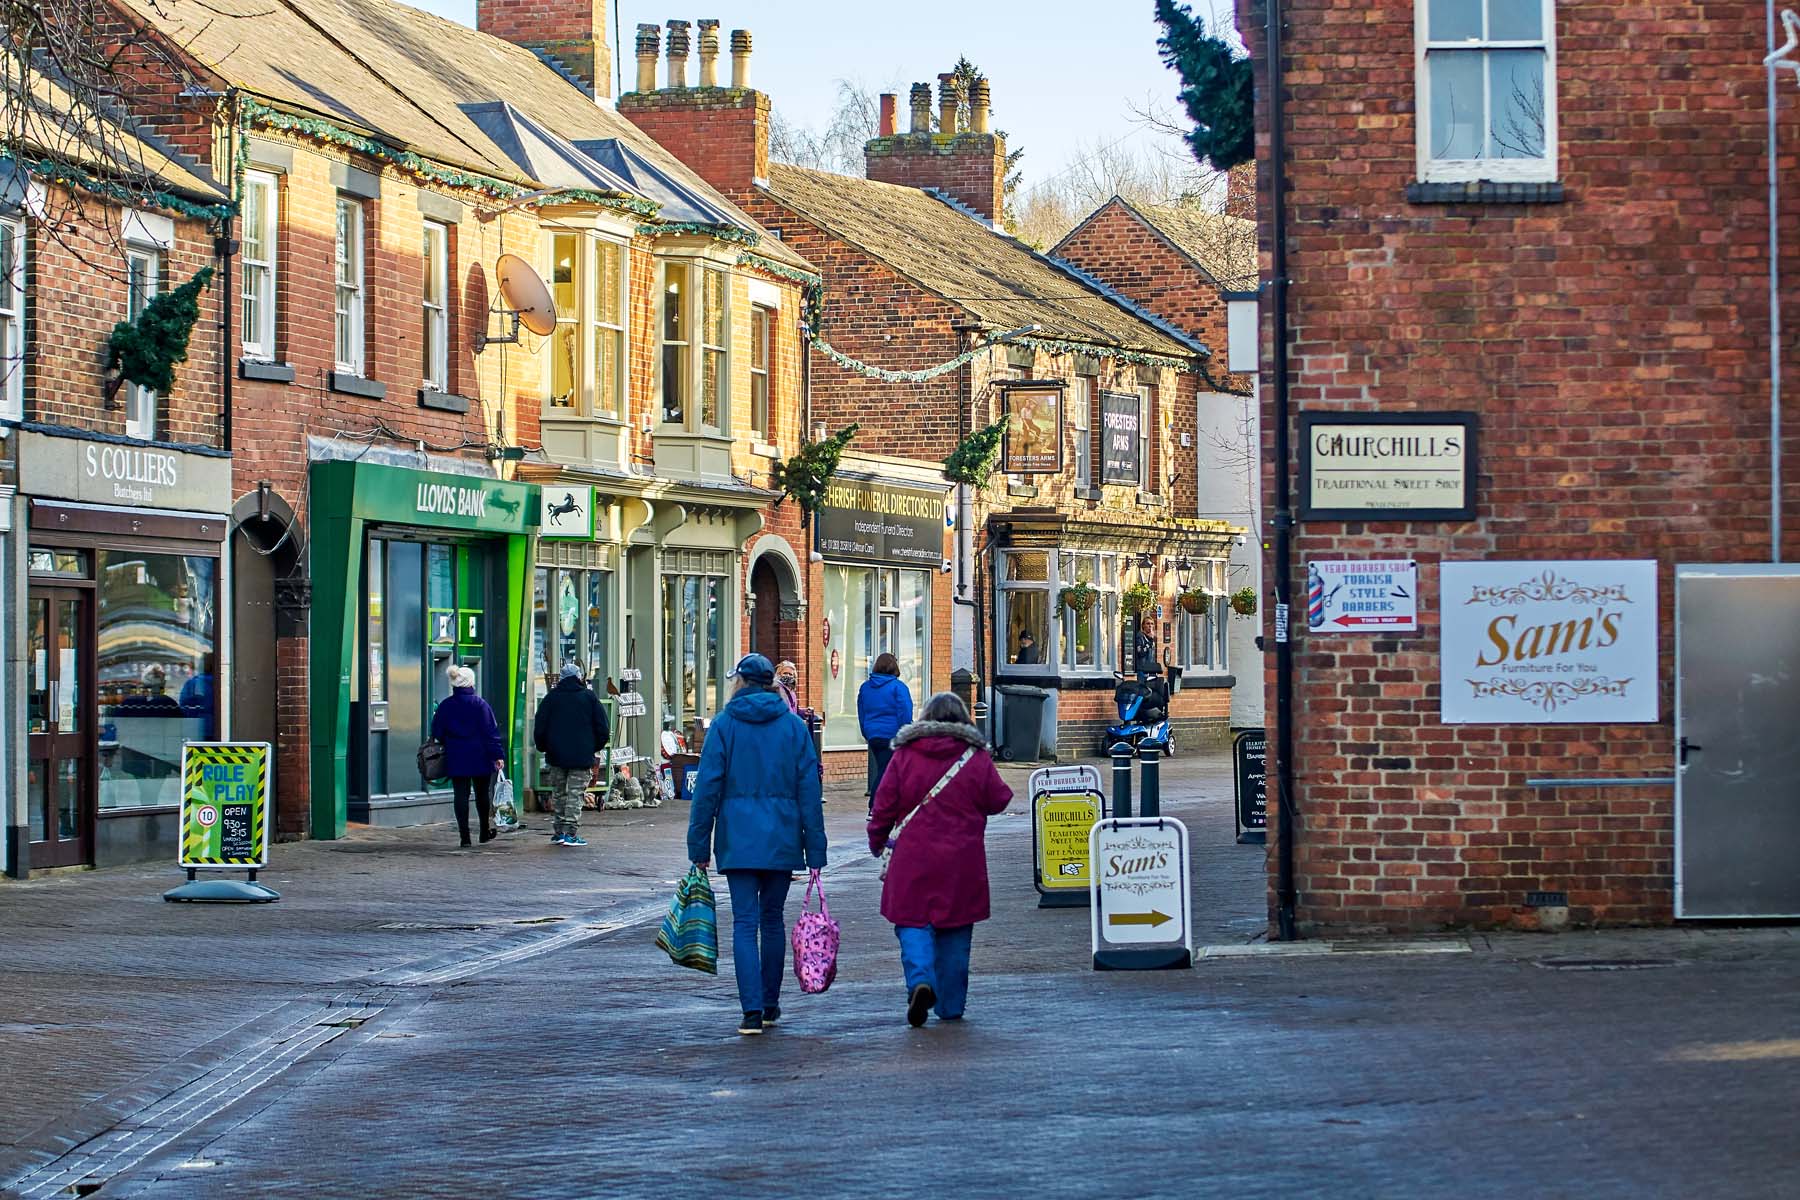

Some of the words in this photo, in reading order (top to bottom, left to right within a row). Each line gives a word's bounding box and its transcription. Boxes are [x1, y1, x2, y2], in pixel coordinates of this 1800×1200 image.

[1104, 412, 1137, 431] FORESTERS
[1112, 434, 1129, 451] ARMS
[1316, 433, 1461, 458] CHURCHILLS
[86, 444, 97, 477] S
[101, 446, 177, 486] COLLIERS
[113, 483, 143, 500] Butchers
[1315, 478, 1387, 490] TRADITIONAL
[1393, 478, 1430, 489] SWEET
[1434, 479, 1460, 489] SHOP
[416, 482, 457, 515] LLOYDS
[457, 487, 487, 518] BANK
[823, 485, 856, 510] CHERISH
[857, 489, 890, 513] FUNERAL
[890, 493, 929, 519] DIRECTORS
[929, 498, 942, 520] LTD
[854, 519, 881, 535] Independent
[881, 522, 896, 536] Funeral
[896, 524, 914, 537] Directors
[1343, 574, 1393, 585] TURKISH
[1349, 588, 1386, 598] STYLE
[1342, 601, 1395, 612] BARBERS
[1475, 607, 1622, 668] Sam's
[1502, 663, 1553, 673] Furniture
[1556, 663, 1574, 672] For
[1576, 663, 1598, 673] You
[203, 764, 244, 782] ROLE
[214, 784, 255, 801] PLAY
[203, 811, 213, 821] 10
[224, 807, 247, 816] OPEN
[1043, 809, 1094, 822] CHURCHILLS
[1105, 852, 1168, 878] Sam's
